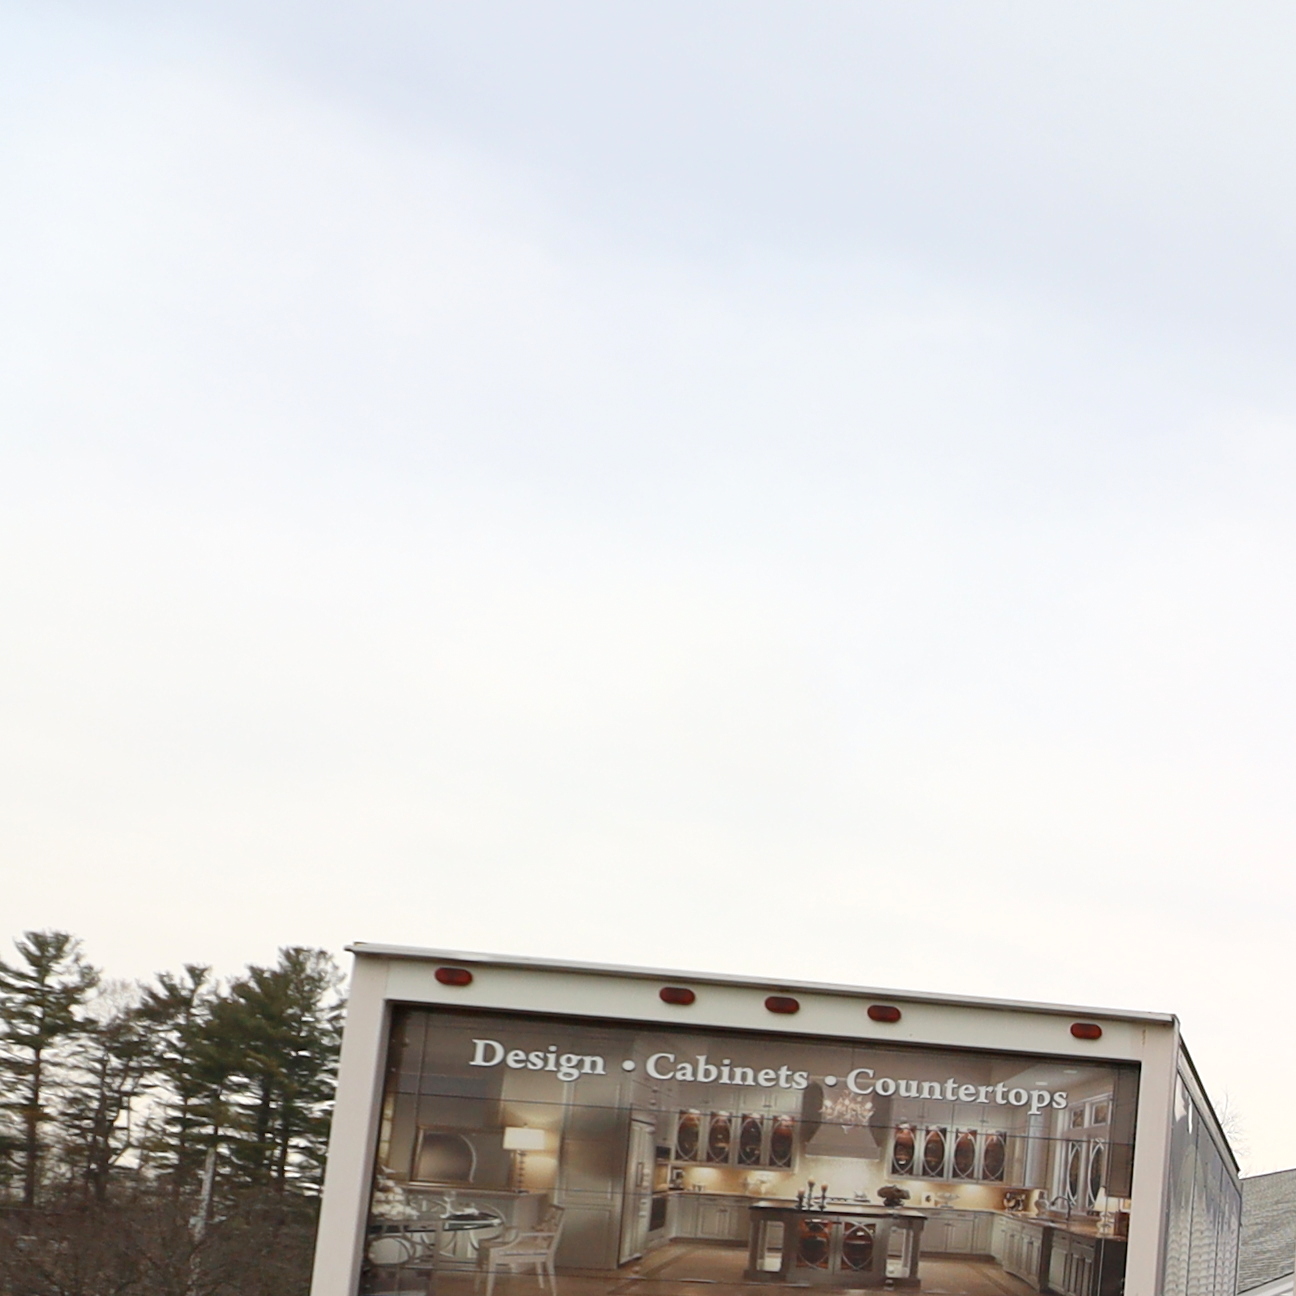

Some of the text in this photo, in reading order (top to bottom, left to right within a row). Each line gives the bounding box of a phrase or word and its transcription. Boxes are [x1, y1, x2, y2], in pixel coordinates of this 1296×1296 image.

[469, 1038, 1069, 1115] Design Cabinets Countertops
